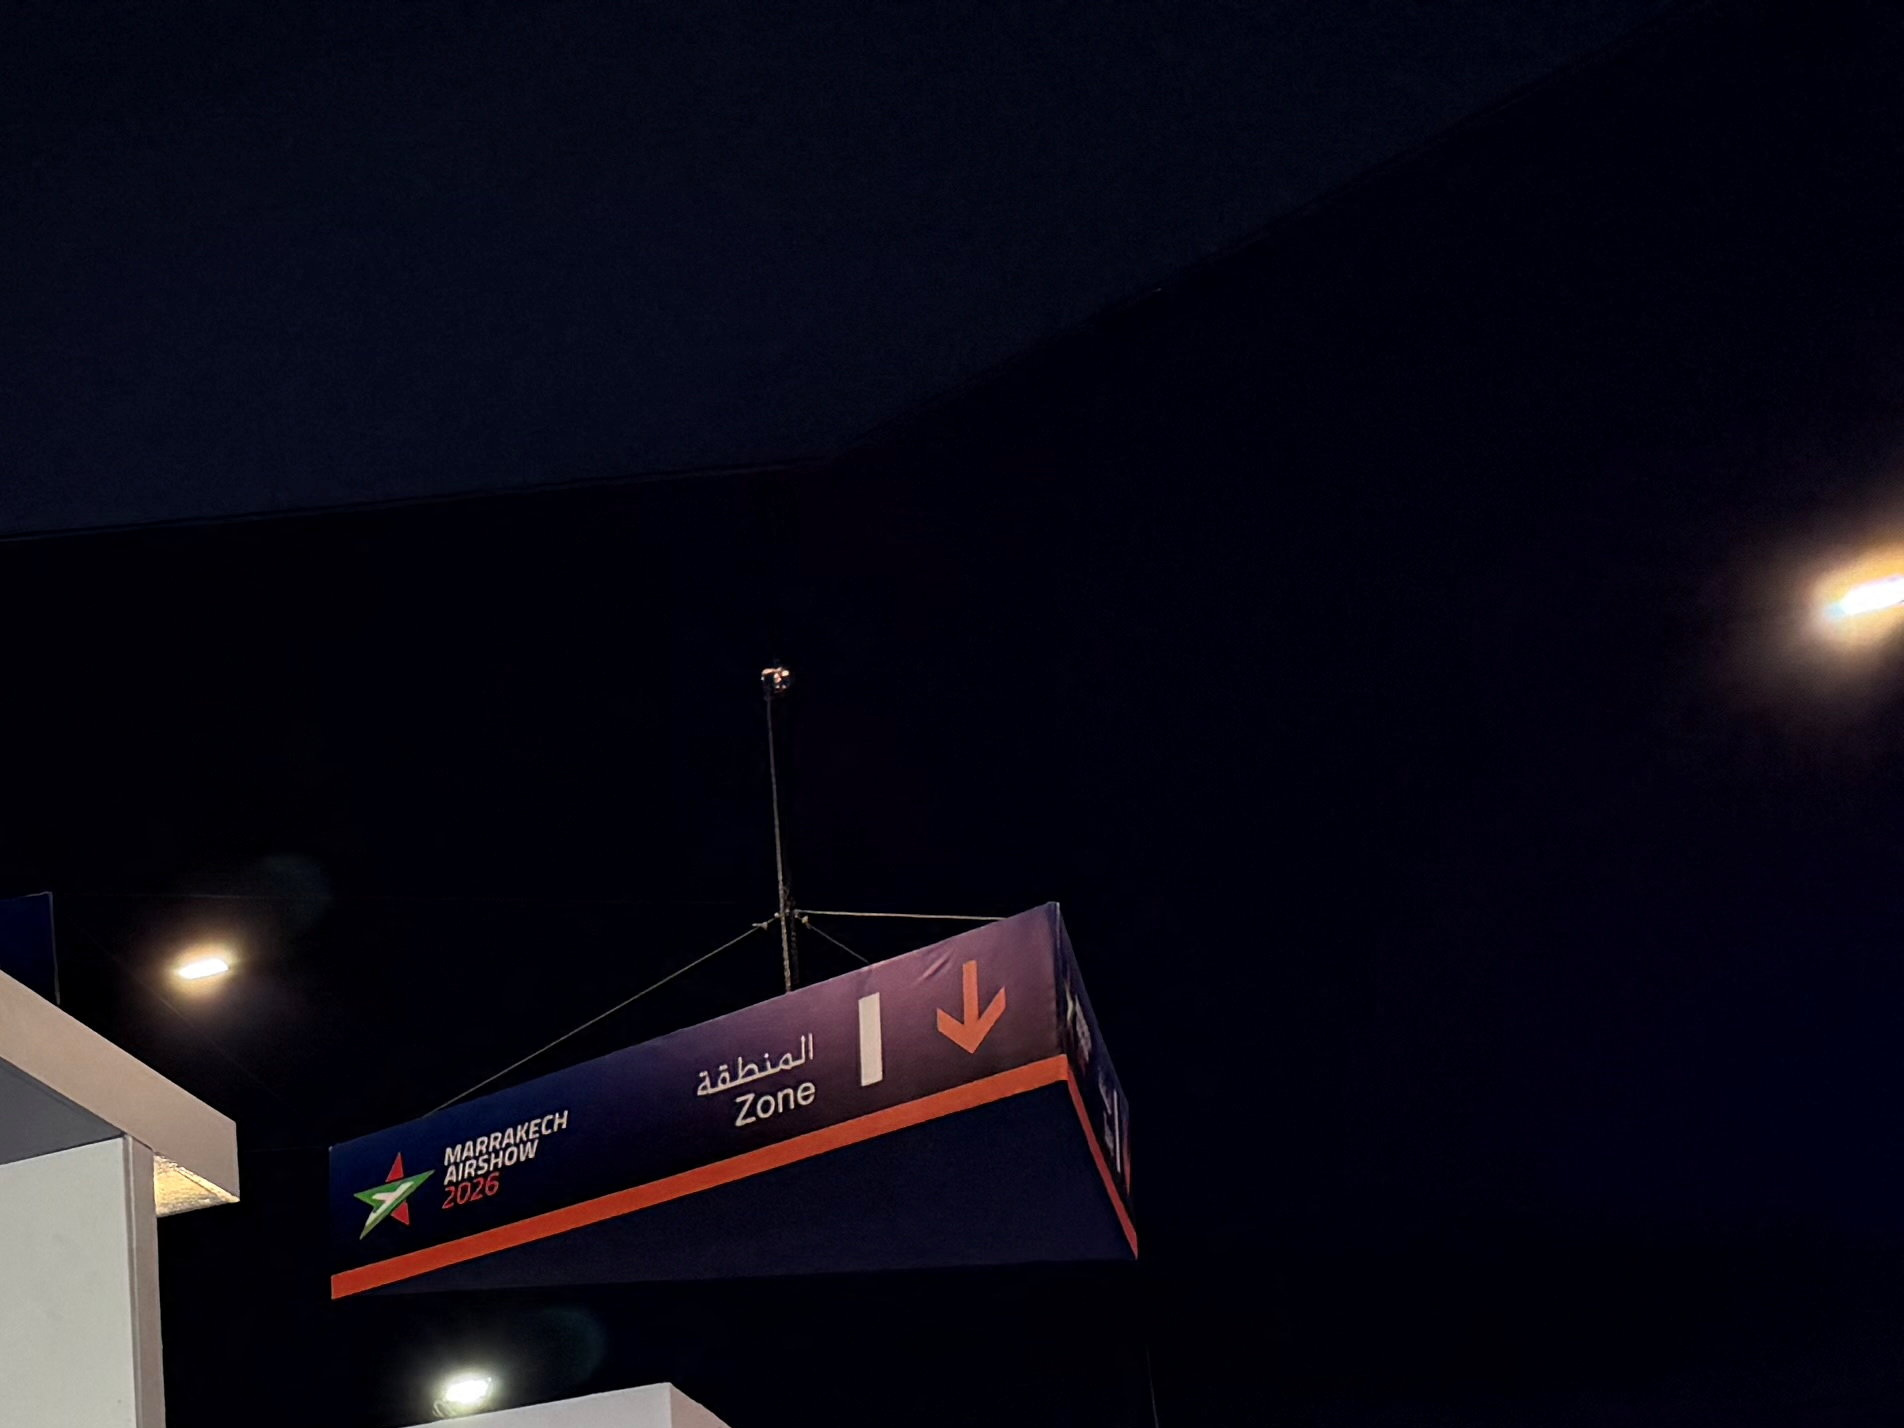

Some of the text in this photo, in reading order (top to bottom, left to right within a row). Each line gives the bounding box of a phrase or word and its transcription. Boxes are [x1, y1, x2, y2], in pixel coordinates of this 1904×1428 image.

[695, 1033, 815, 1100] المنطقة
[735, 1077, 817, 1128] Zone
[443, 1140, 539, 1187] AIRSHOW
[444, 1109, 569, 1167] MARRAKECH
[441, 1172, 500, 1211] 2026
